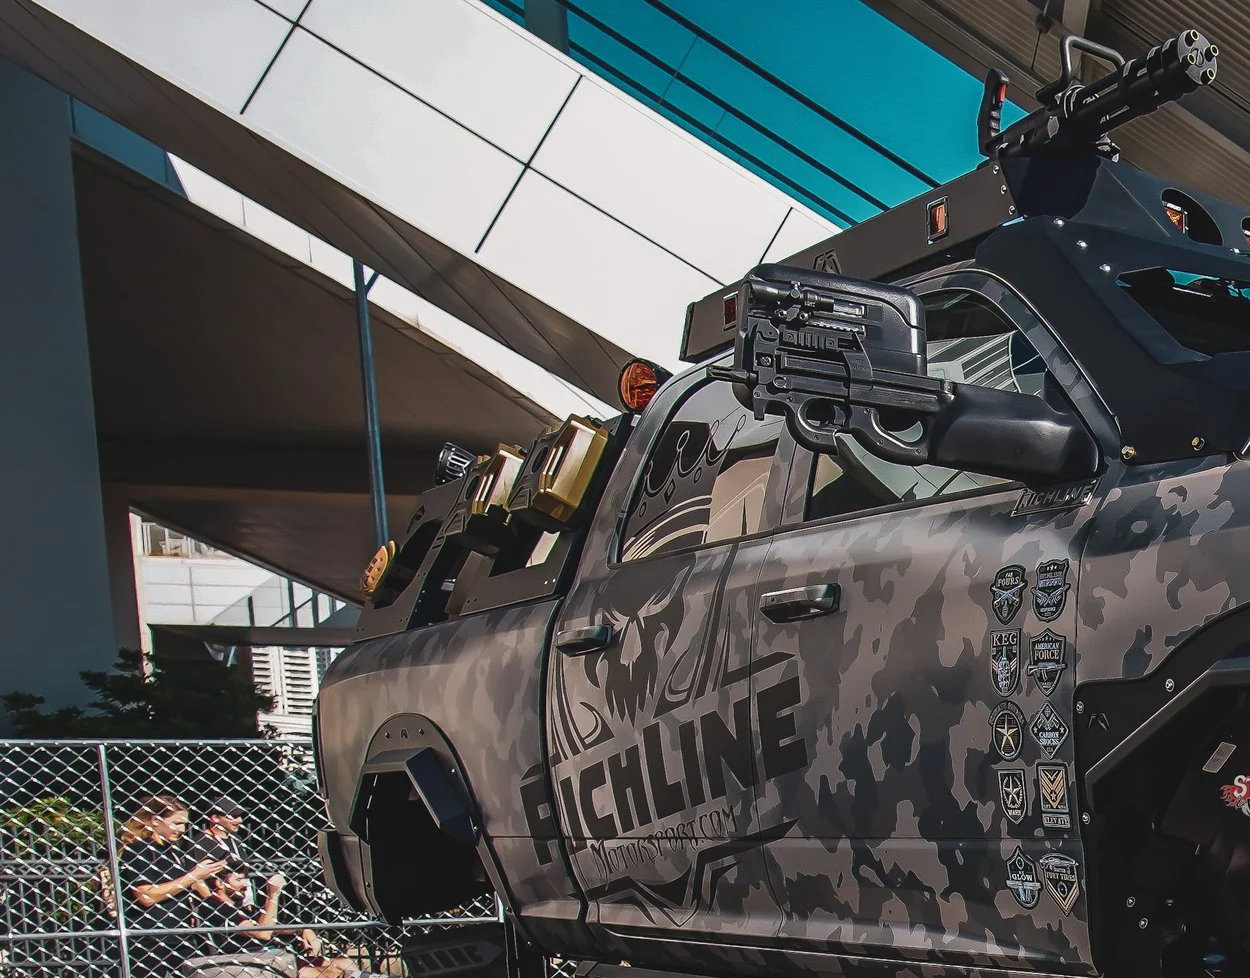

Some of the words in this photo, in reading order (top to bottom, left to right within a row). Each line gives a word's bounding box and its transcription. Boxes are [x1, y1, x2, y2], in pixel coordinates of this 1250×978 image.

[998, 576, 1020, 587] FOURS
[993, 632, 1017, 646] KEG
[1034, 642, 1060, 650] AMERICAN
[1034, 650, 1060, 660] FORCE
[520, 676, 809, 866] RICHLINE
[1044, 816, 1071, 826] ELEVATE
[1011, 873, 1033, 882] GLOW
